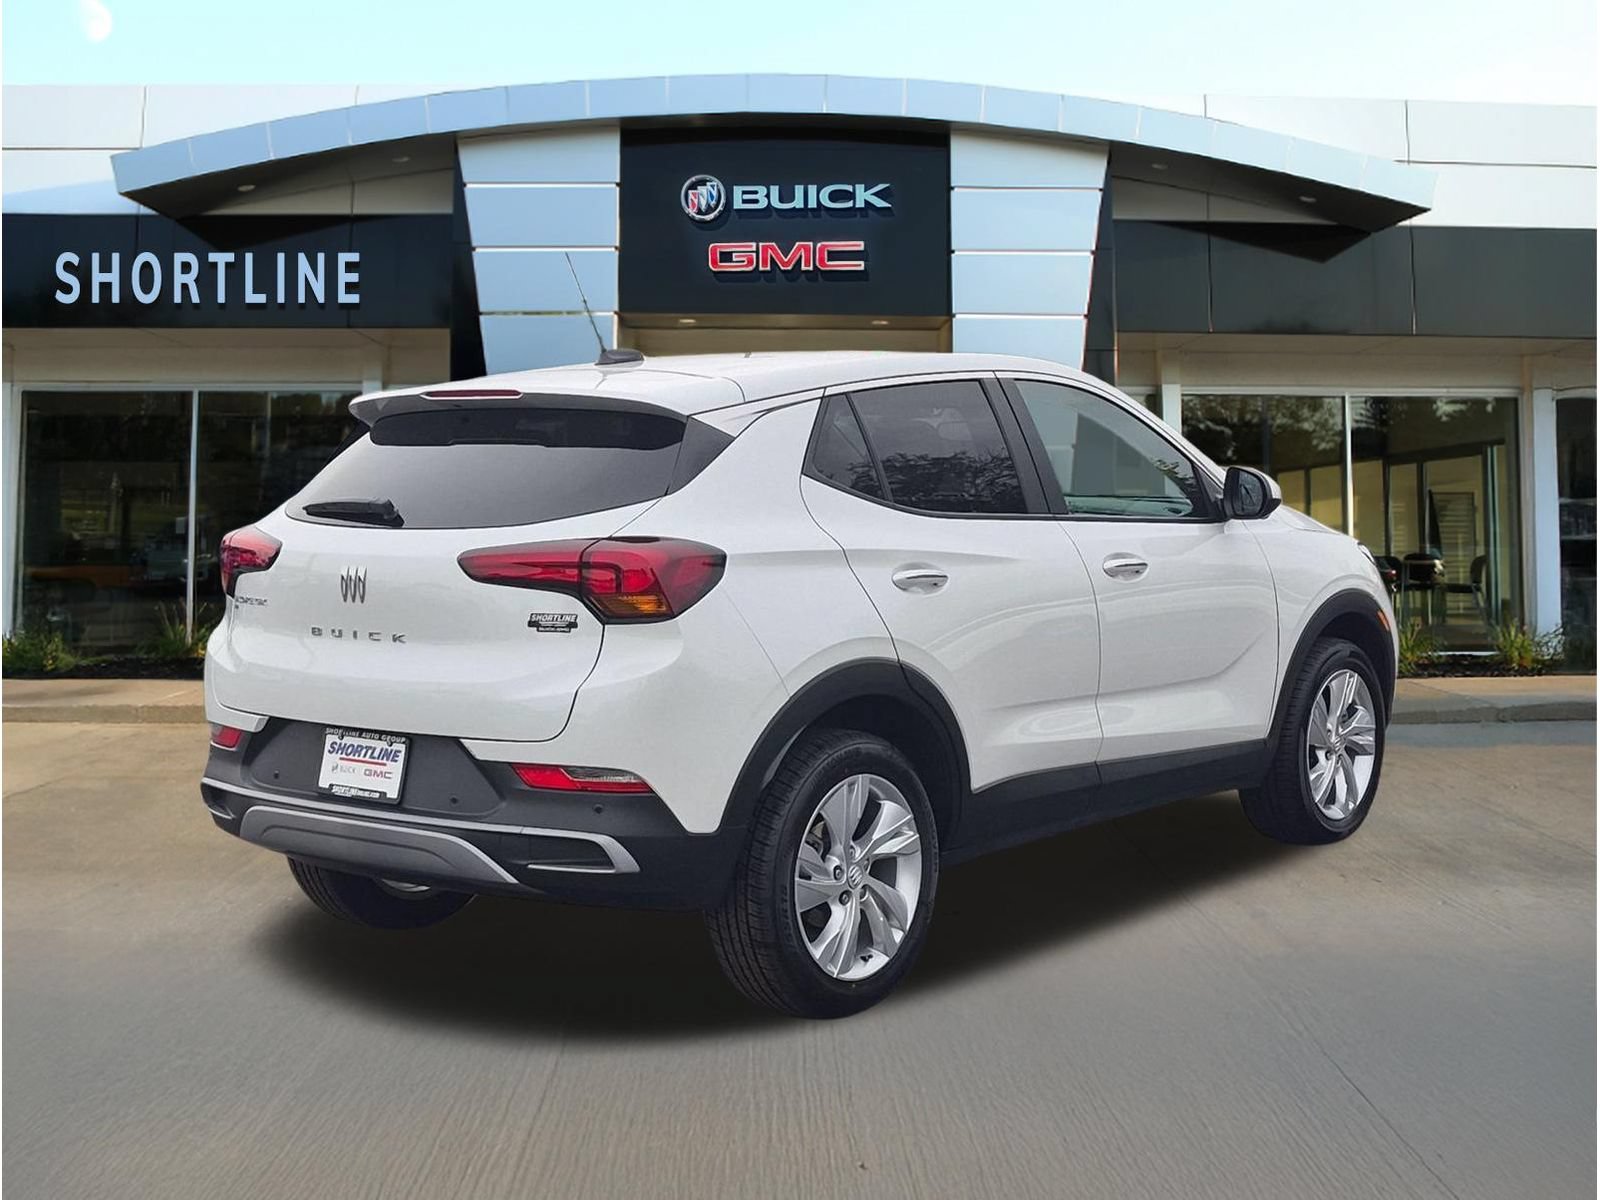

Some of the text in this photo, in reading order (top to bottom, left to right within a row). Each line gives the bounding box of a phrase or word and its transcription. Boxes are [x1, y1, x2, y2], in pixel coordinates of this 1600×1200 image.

[733, 184, 892, 209] BUICK
[709, 241, 864, 271] GMC
[55, 252, 360, 304] SHORTLINE
[531, 614, 577, 622] SHORTLINE
[311, 626, 407, 644] BUICK
[362, 731, 380, 740] AUTO
[328, 741, 401, 763] SHORTLINE
[364, 768, 393, 779] GMC
